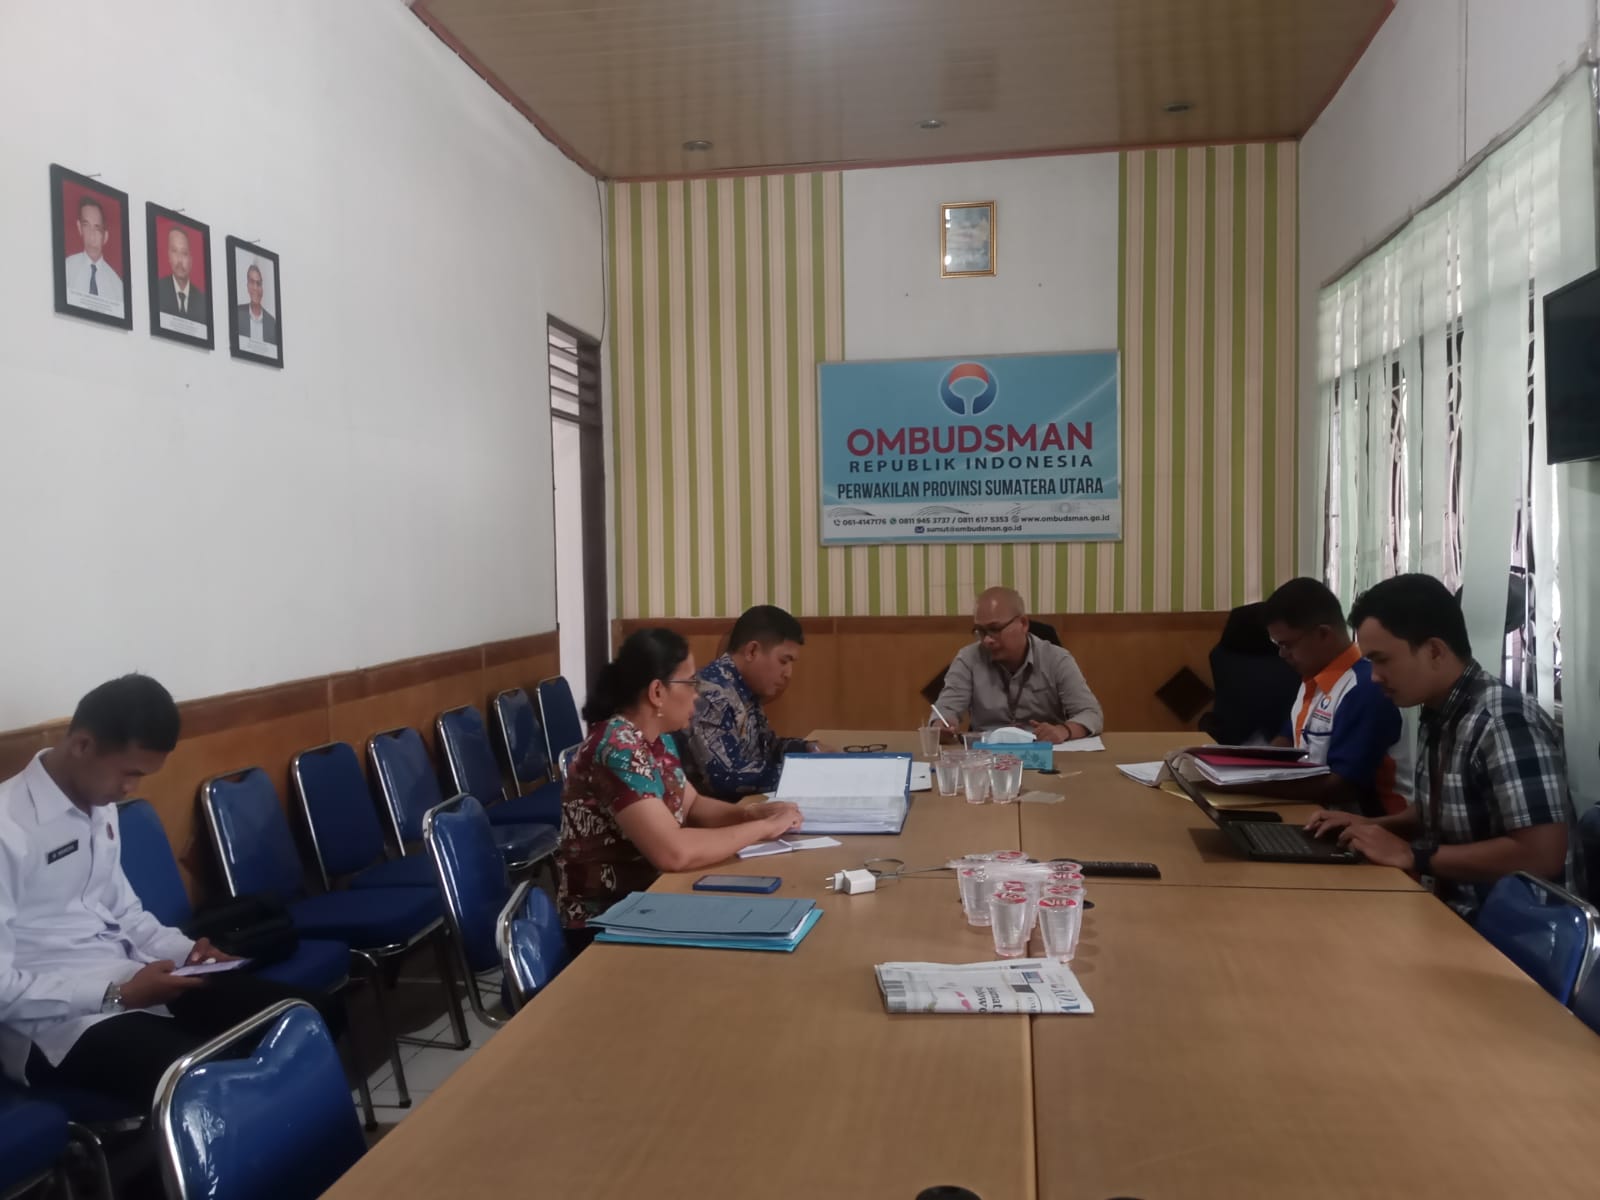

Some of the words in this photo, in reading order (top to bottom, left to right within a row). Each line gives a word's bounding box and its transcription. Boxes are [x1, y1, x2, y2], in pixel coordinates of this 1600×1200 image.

[847, 422, 1093, 457] OMBUDSMAN
[850, 457, 956, 473] REPUBLIK
[966, 455, 1093, 470] INDONESIA
[837, 481, 919, 499] PERWAKILAN
[923, 480, 982, 497] PROVINSI
[985, 479, 1056, 496] SUMATERA
[1059, 477, 1104, 494] UTARA
[957, 516, 974, 524] 0811
[1021, 514, 1110, 523] www.ombudsman.go.id
